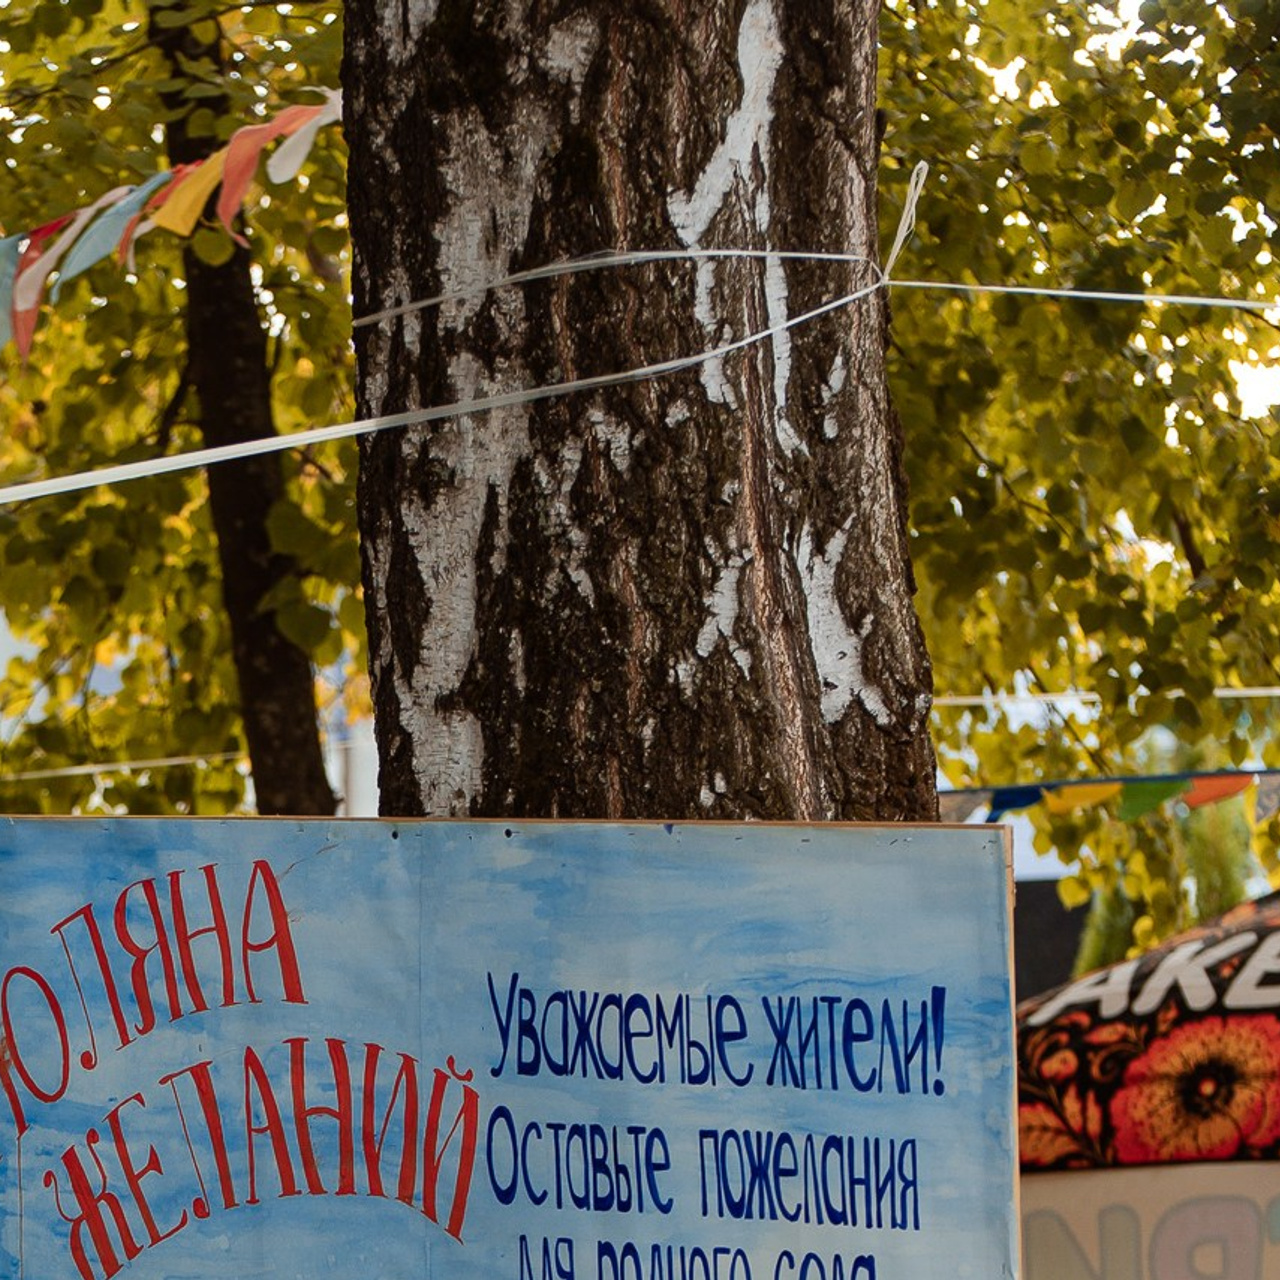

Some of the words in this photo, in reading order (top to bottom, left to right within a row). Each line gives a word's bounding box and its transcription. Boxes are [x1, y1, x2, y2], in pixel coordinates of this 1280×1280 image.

[488, 972, 754, 1087] Уважаемые
[762, 985, 947, 1096] жители!
[486, 1105, 674, 1215] Оставьте
[699, 1128, 920, 1231] пожелания
